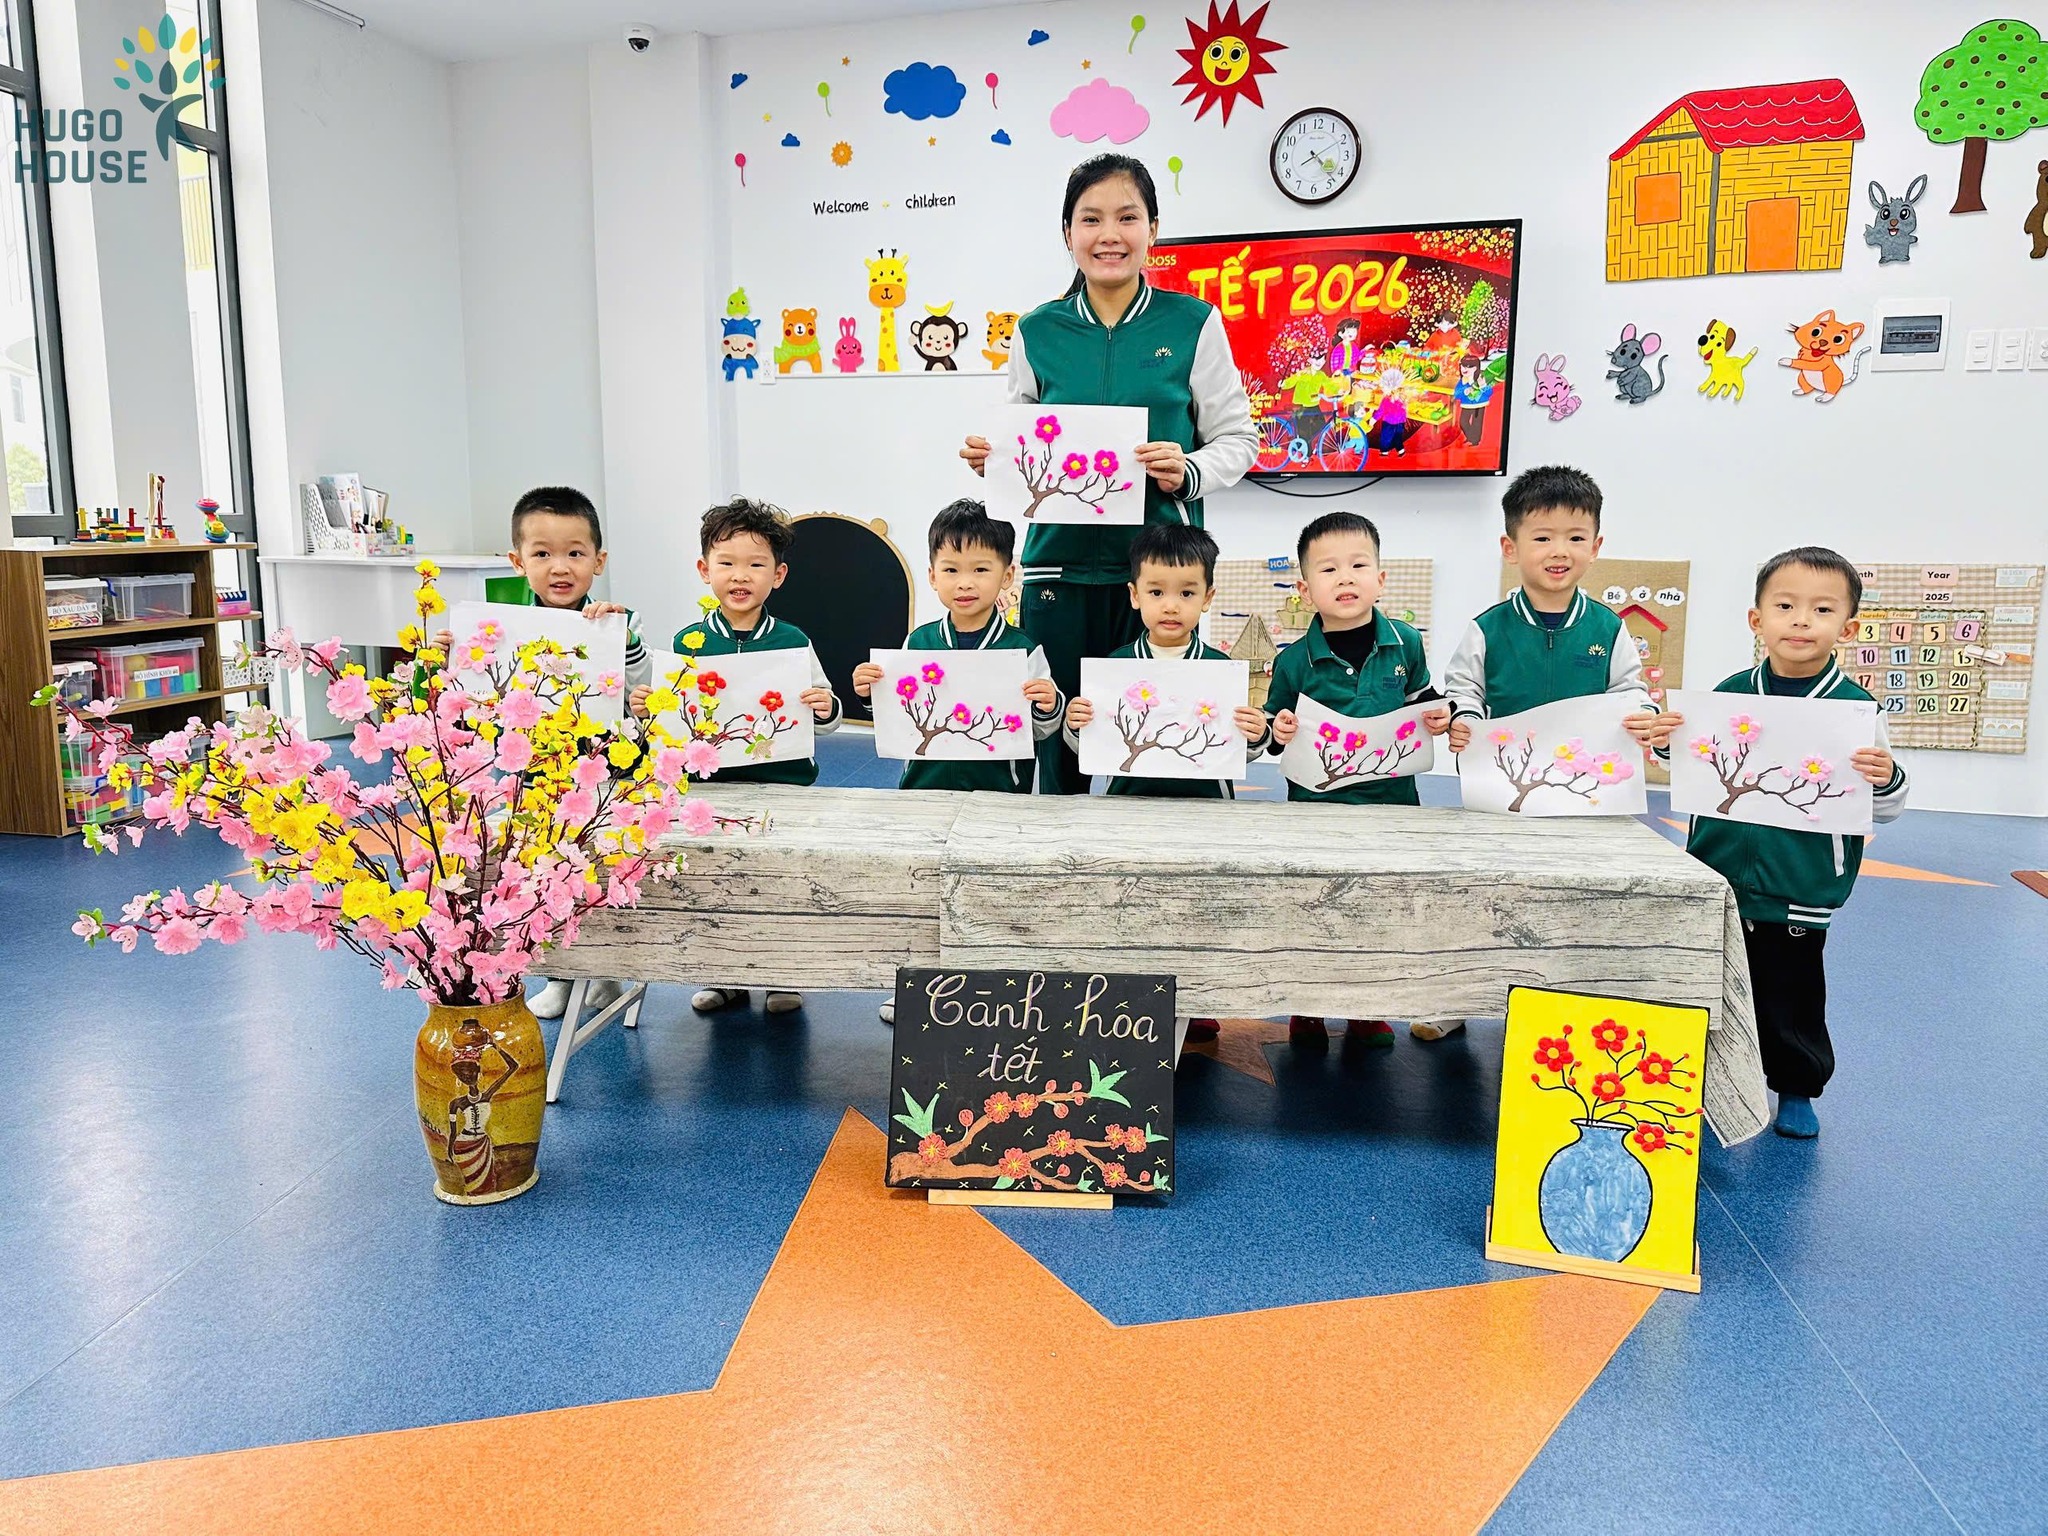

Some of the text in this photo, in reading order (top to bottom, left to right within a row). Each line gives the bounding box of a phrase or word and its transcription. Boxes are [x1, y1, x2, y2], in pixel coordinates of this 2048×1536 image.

[1298, 124, 1306, 134] 11
[1313, 118, 1324, 130] 12
[1331, 122, 1335, 134] 1
[1286, 136, 1296, 146] 10
[1340, 134, 1347, 145] 2
[1282, 152, 1288, 163] 9
[1344, 150, 1350, 161] 3
[1285, 168, 1292, 179] 8
[1338, 166, 1344, 177] 4
[1296, 180, 1302, 190] 7
[1310, 184, 1317, 194] 6
[1326, 179, 1332, 190] 5
[813, 192, 956, 215] Welcome children
[1188, 245, 1409, 317] TẾT 2026
[1270, 560, 1290, 568] HOA
[1607, 592, 1621, 600] Bé
[1865, 624, 1972, 640] 3 4 5 6
[1861, 650, 1875, 664] 10
[1894, 650, 1906, 664] 11
[1922, 648, 1936, 662] 12
[1859, 672, 1968, 688] 17 18 19 20
[1886, 698, 1968, 712] 25 26 27
[976, 1035, 1044, 1084] tết
